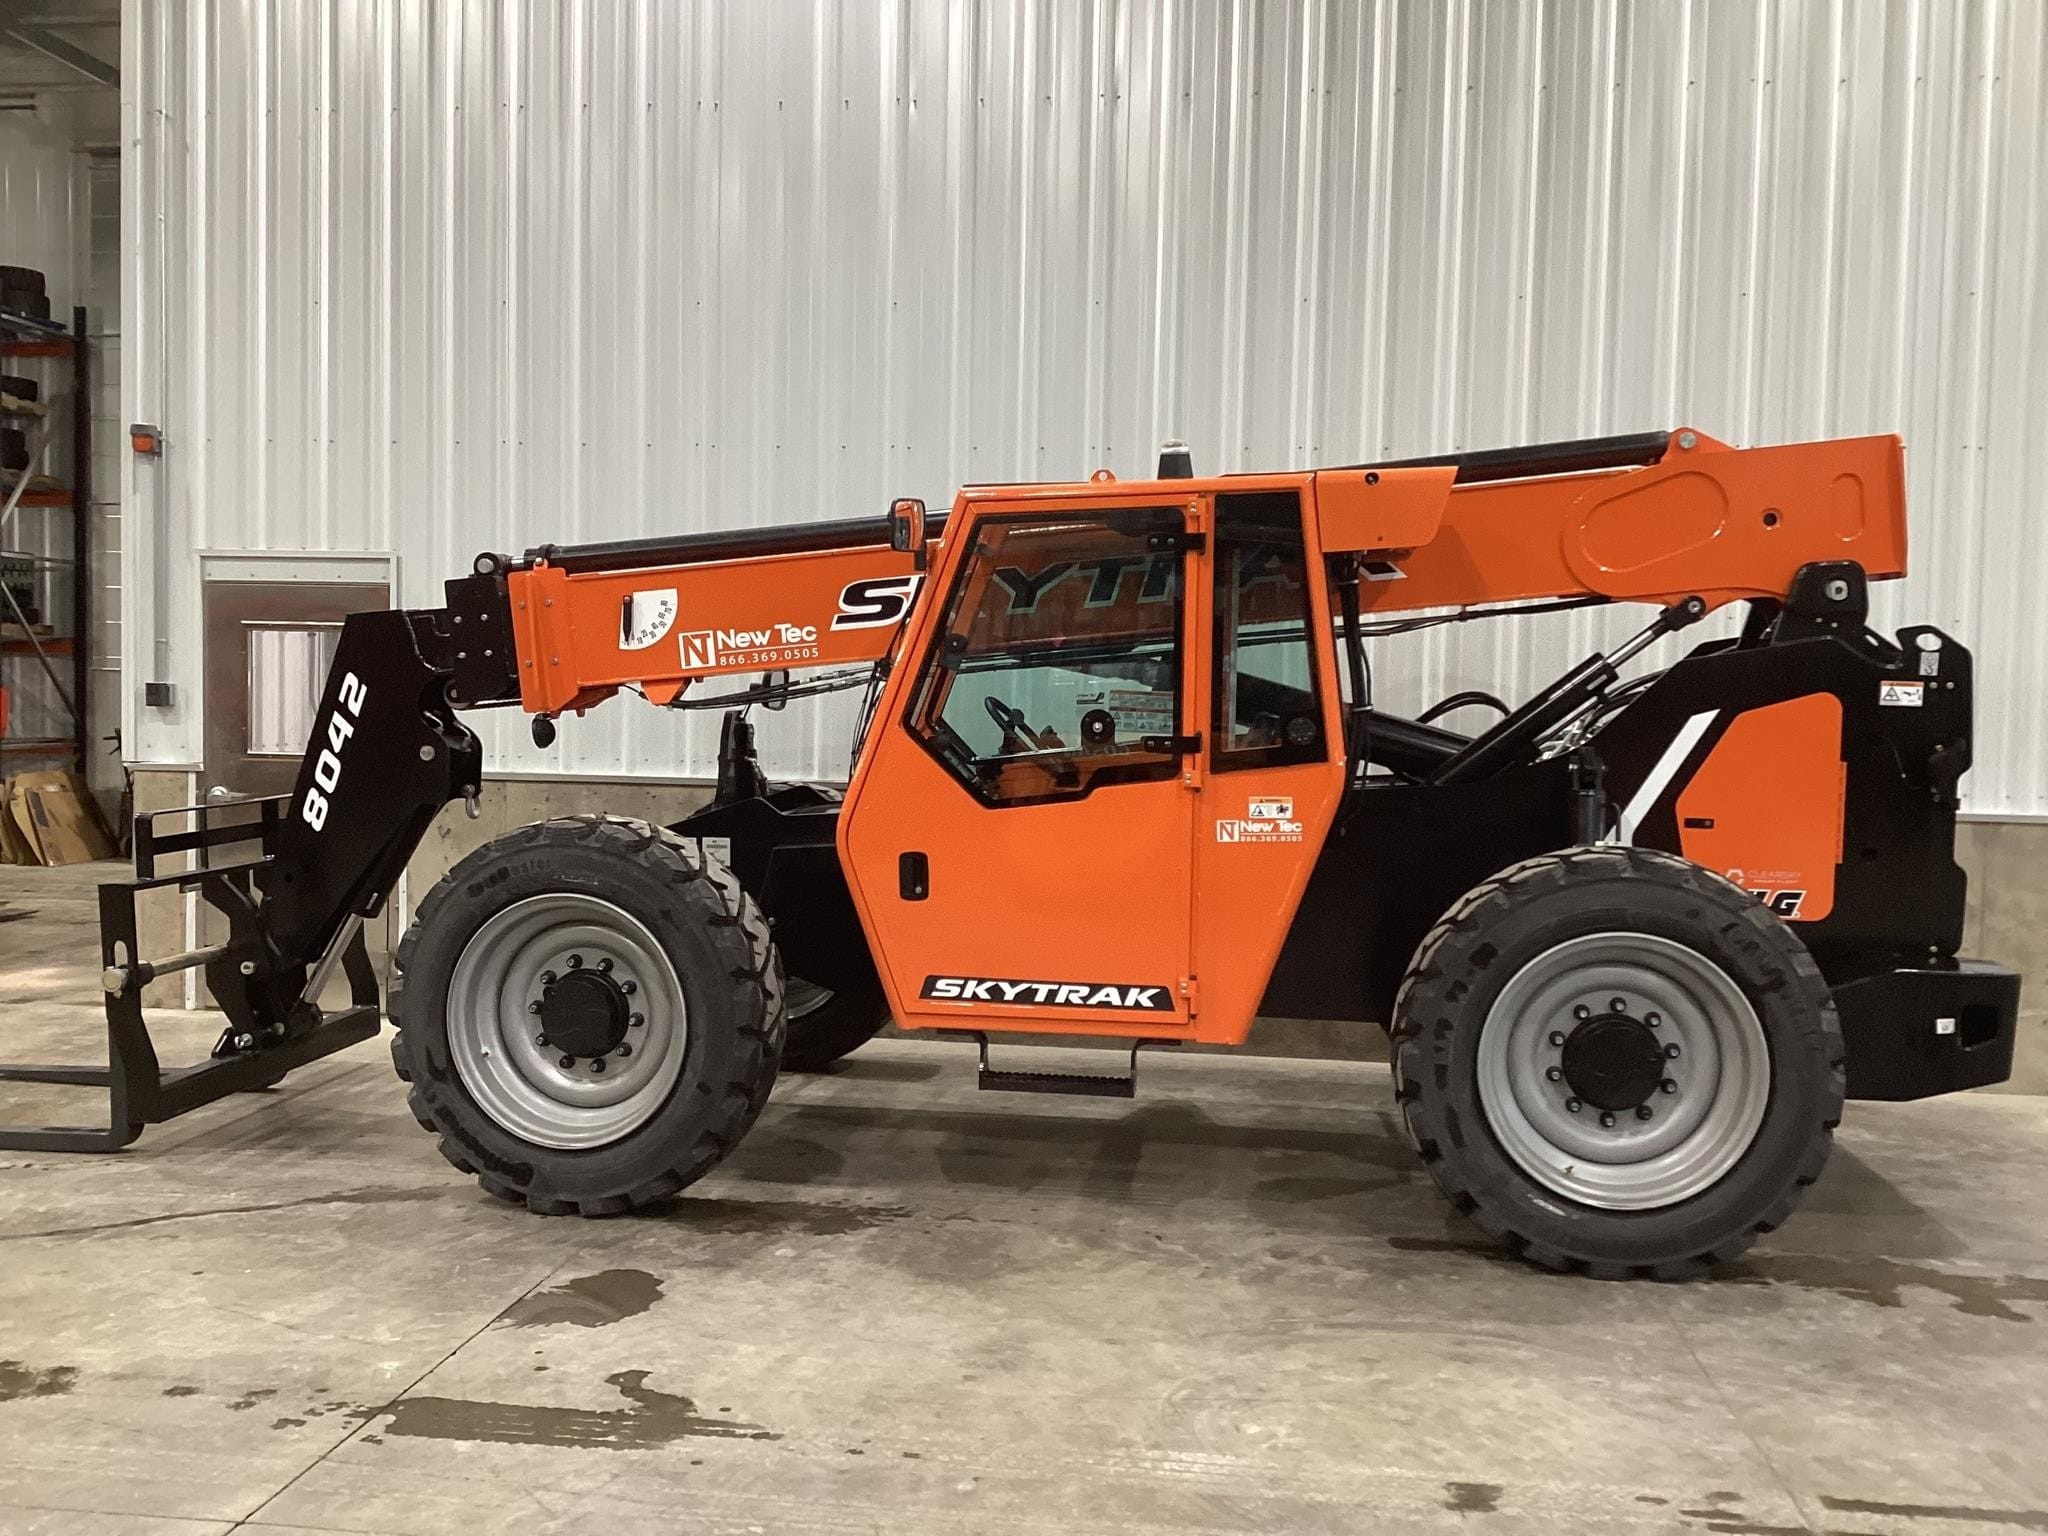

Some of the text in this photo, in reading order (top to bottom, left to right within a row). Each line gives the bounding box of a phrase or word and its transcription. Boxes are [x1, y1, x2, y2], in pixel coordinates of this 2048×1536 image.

[641, 629, 649, 639] 20
[716, 623, 817, 649] New Tec
[719, 648, 819, 666] 866.369.0505
[302, 671, 368, 833] 8042
[1241, 820, 1303, 833] New Tec
[931, 978, 1161, 1007] SKYTRAK
